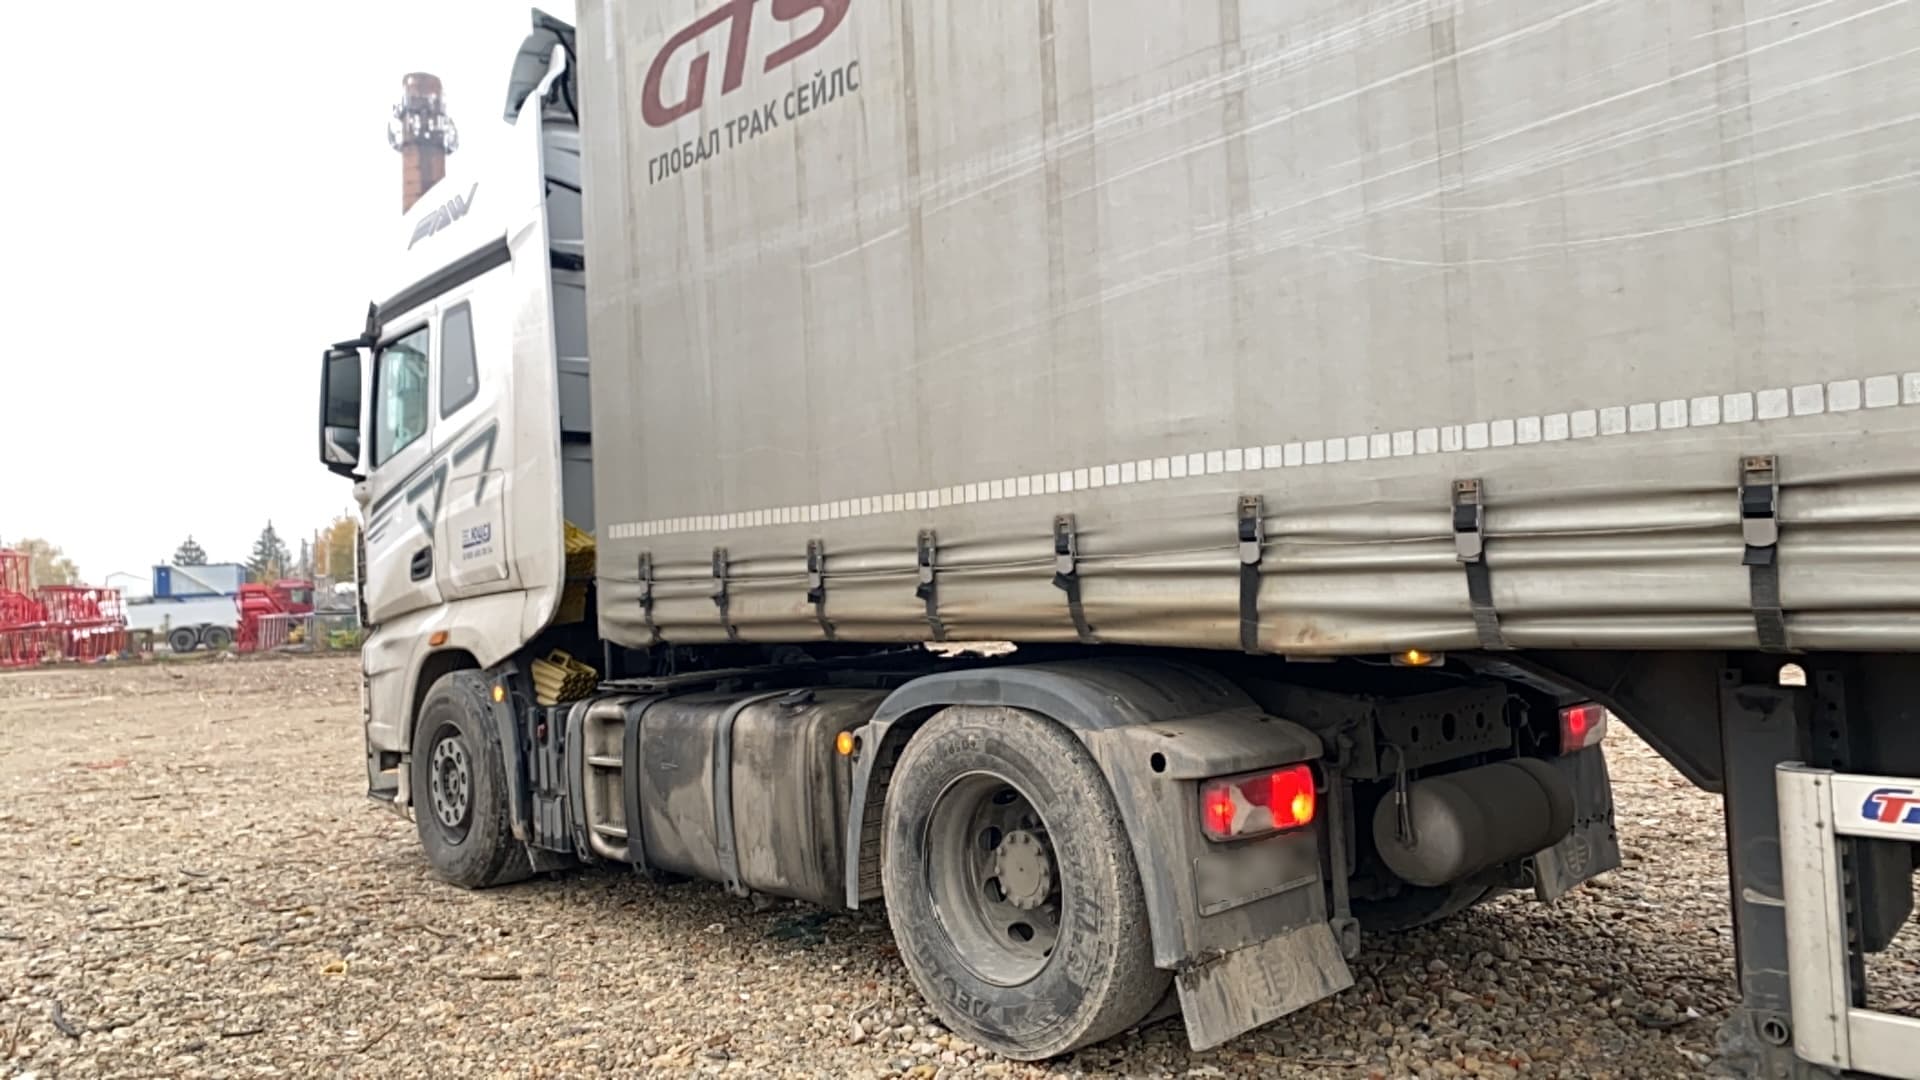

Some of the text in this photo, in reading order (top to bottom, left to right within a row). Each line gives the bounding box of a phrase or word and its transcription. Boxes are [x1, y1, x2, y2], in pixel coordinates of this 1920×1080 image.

[641, 0, 851, 128] GTS
[648, 60, 859, 185] ГЛОБАЛ ТРАК СЕЙЛС
